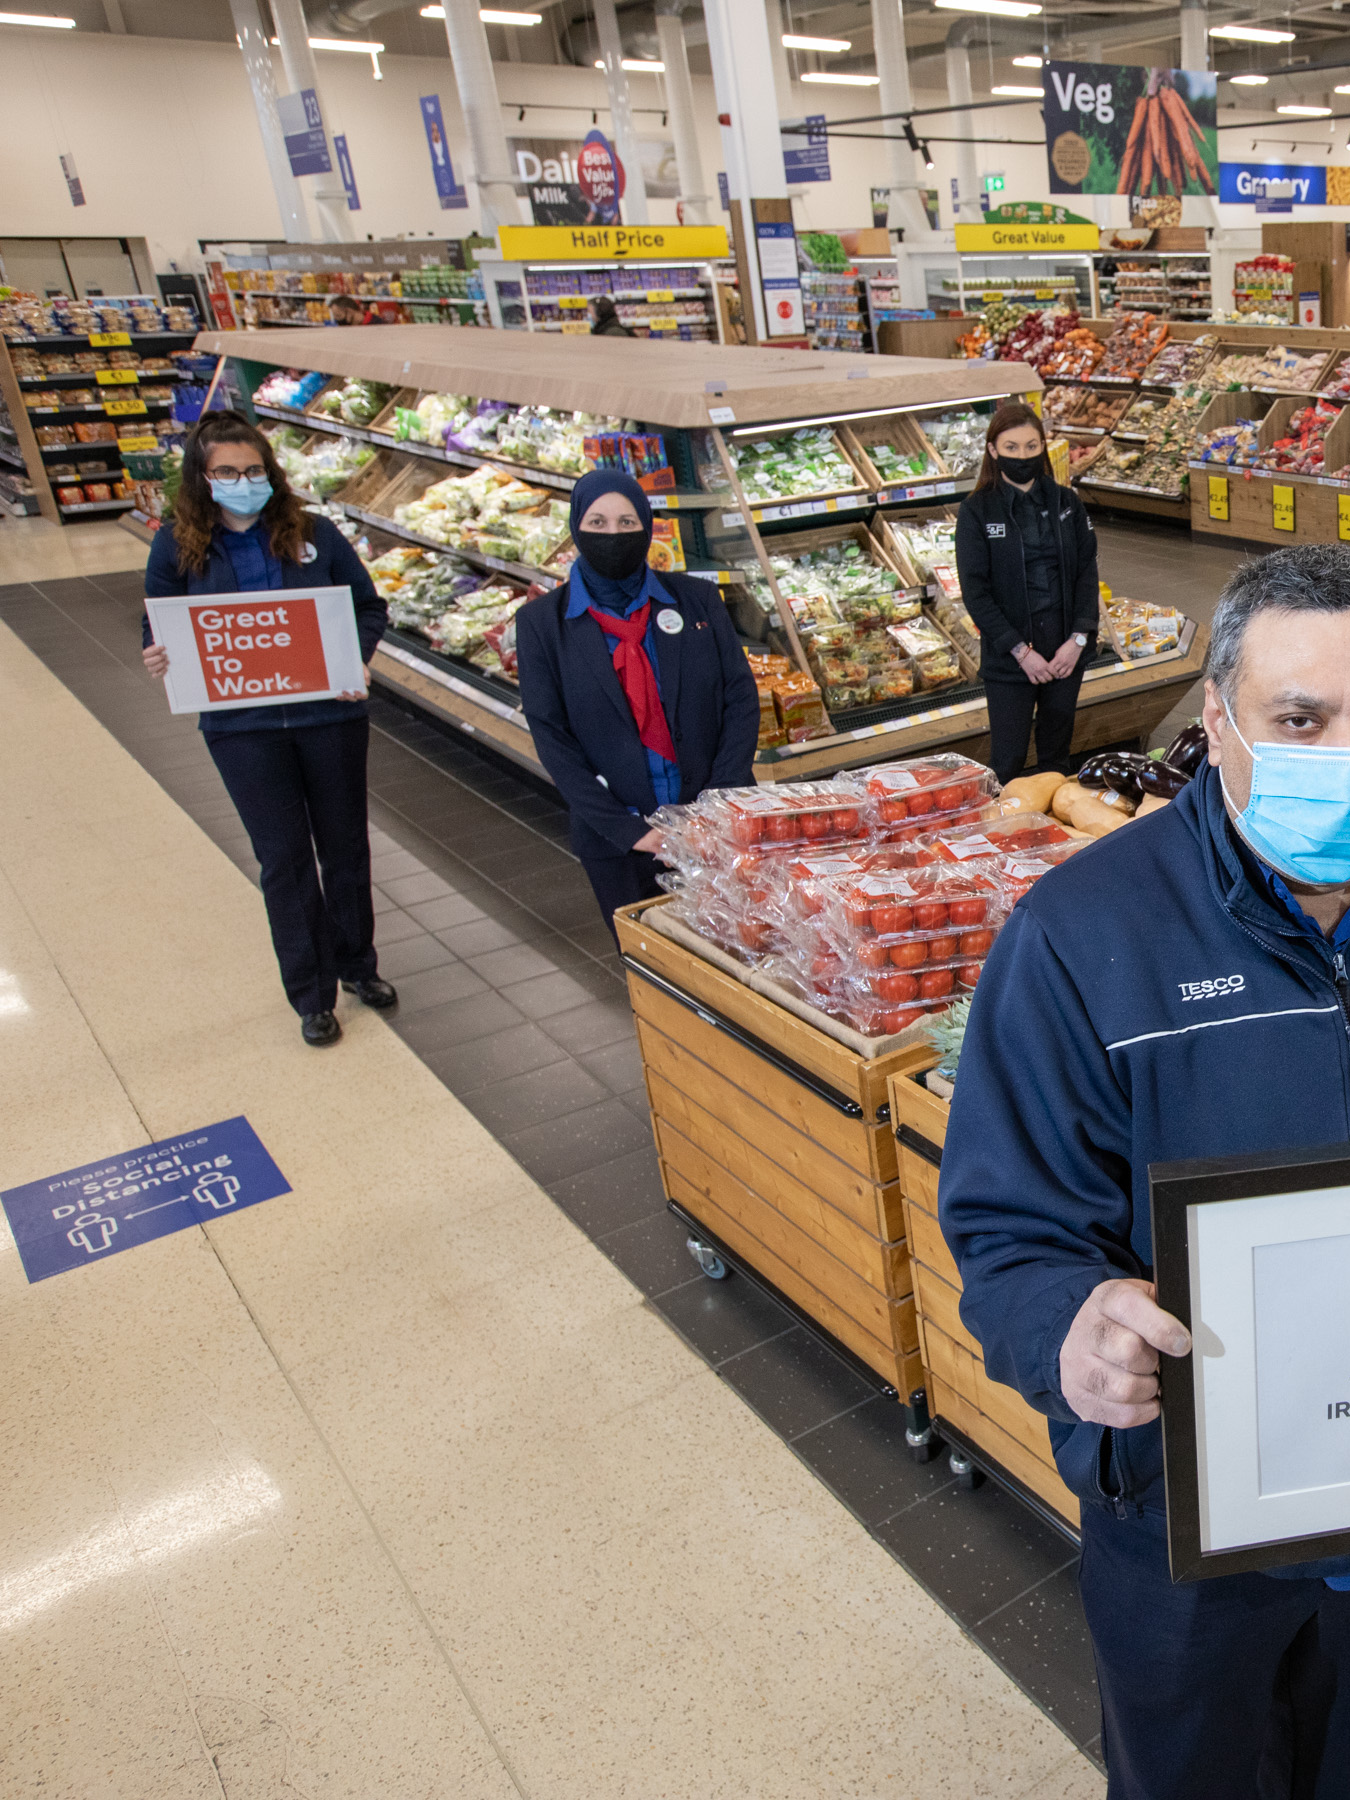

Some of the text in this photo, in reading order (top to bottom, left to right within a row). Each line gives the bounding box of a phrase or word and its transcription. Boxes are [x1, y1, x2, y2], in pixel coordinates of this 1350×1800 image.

[1051, 71, 1115, 124] Veg
[532, 187, 569, 204] Milk
[572, 230, 664, 248] Half Price
[993, 232, 1065, 245] Great Value
[1209, 494, 1228, 504] €2.49
[1273, 504, 1294, 513] €2.49
[778, 504, 793, 519] €1
[198, 606, 290, 631] Great
[204, 632, 292, 653] Place
[206, 655, 243, 675] To
[1178, 974, 1245, 997] TESCO
[48, 1136, 209, 1194] Please practice
[82, 1155, 184, 1197] Social
[52, 1154, 234, 1221] Distancing
